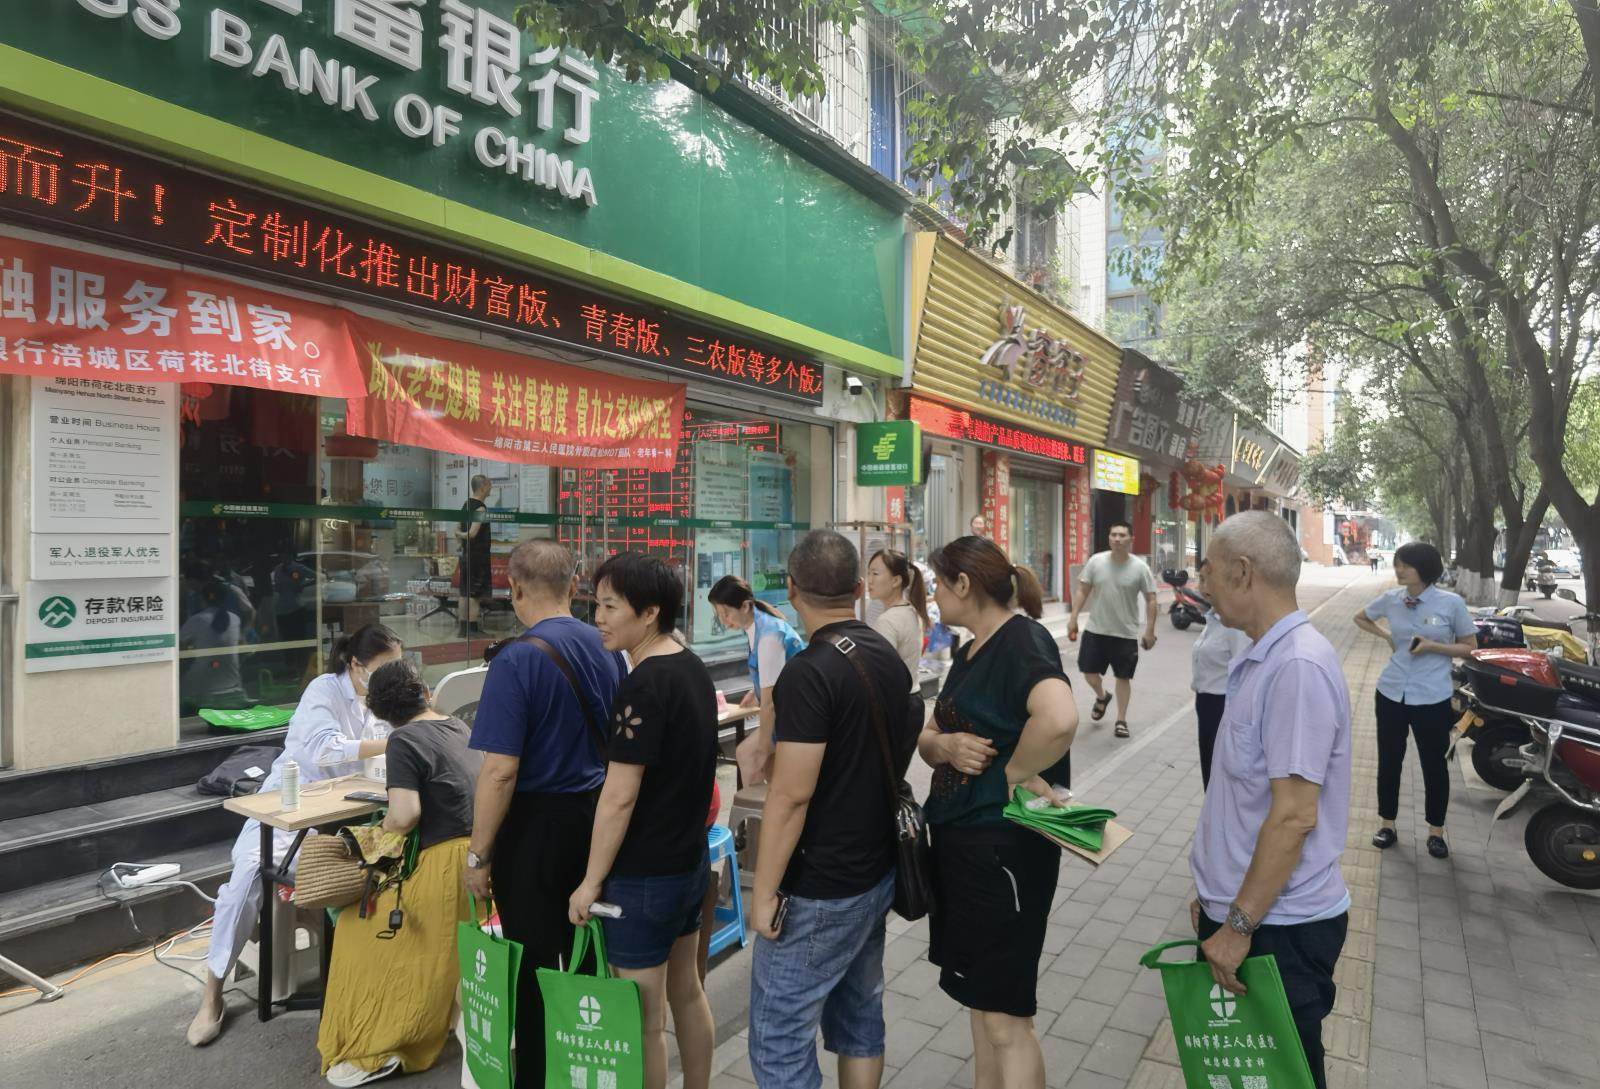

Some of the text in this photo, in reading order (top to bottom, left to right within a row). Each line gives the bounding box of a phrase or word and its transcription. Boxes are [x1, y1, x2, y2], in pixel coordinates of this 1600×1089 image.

[264, 0, 602, 145] 蓄银行
[209, 6, 380, 121] BANK
[393, 92, 463, 147] OF
[474, 126, 599, 206] CHINA
[0, 336, 322, 388] 行涪城区荷花北街支行
[490, 370, 569, 437] 关注骨密度
[49, 415, 161, 432] 营业时间 Business Hours
[49, 546, 160, 558] 军人、退役军人优先
[84, 595, 164, 616] 存款保险
[85, 614, 164, 625] DEPOSIT INSURANCE
